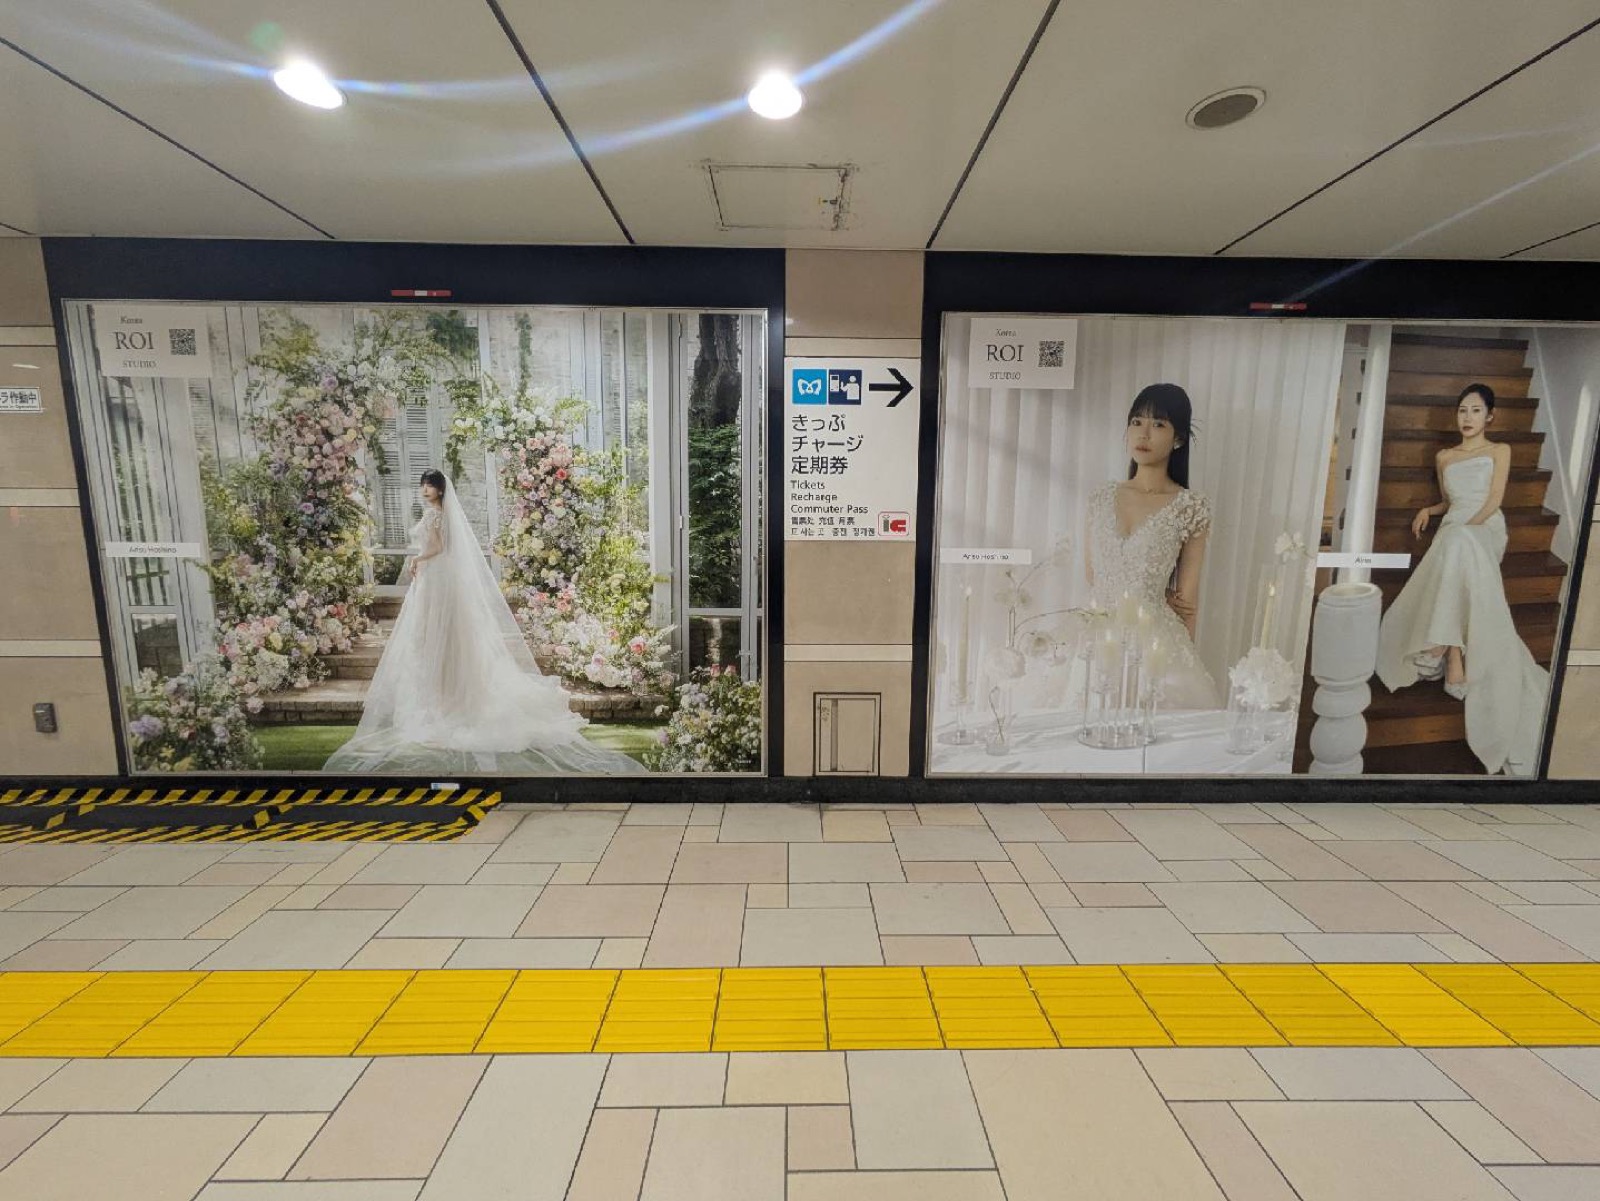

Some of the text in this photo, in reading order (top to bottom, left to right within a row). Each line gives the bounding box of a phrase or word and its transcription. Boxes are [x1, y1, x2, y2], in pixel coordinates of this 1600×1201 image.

[114, 331, 155, 350] ROI
[986, 344, 1025, 361] ROI
[792, 414, 846, 431] きっぷ
[792, 434, 864, 452] チャージ
[792, 456, 848, 474] 定期券
[790, 480, 826, 489] Tickets
[790, 493, 838, 503] Recharge
[790, 505, 869, 514] Commuter Pass
